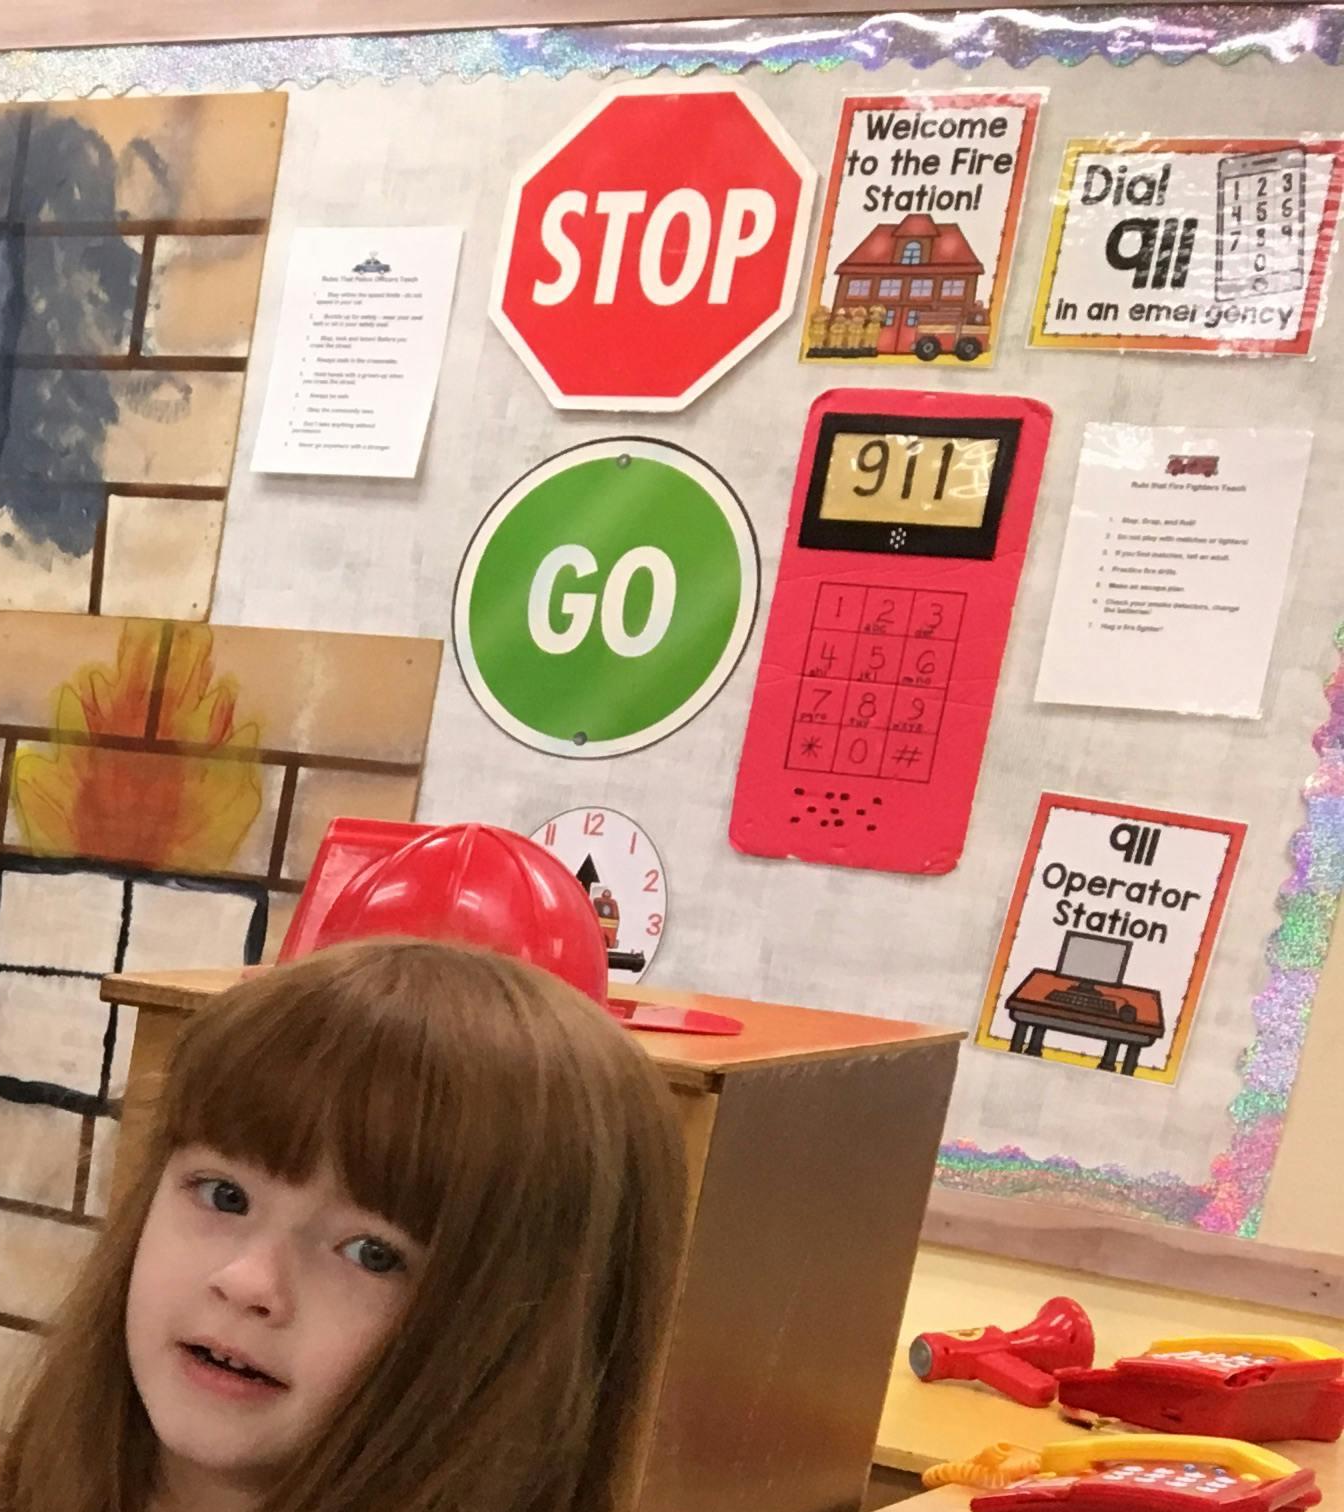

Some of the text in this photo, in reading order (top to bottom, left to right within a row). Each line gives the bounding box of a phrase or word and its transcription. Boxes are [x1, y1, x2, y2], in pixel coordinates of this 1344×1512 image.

[868, 113, 1007, 140] Welcome
[848, 148, 1012, 176] to the Fire
[864, 184, 982, 211] Station!
[1081, 164, 1170, 205] Dial
[532, 188, 777, 307] STOP
[1106, 218, 1197, 289] 911
[1056, 299, 1292, 329] in an emergency
[853, 439, 955, 501] 911
[527, 544, 677, 658] GO
[877, 599, 895, 624] 2
[929, 603, 943, 629] 3
[820, 641, 935, 674] 4 5 6
[813, 689, 925, 721] 7 8 9
[849, 738, 868, 764] 0
[583, 812, 606, 836] 12
[629, 832, 638, 854] 1
[1110, 822, 1161, 866] 911
[643, 869, 660, 893] 2
[1042, 862, 1202, 911] Operator
[646, 914, 664, 937] 3
[1052, 900, 1168, 944] Station
